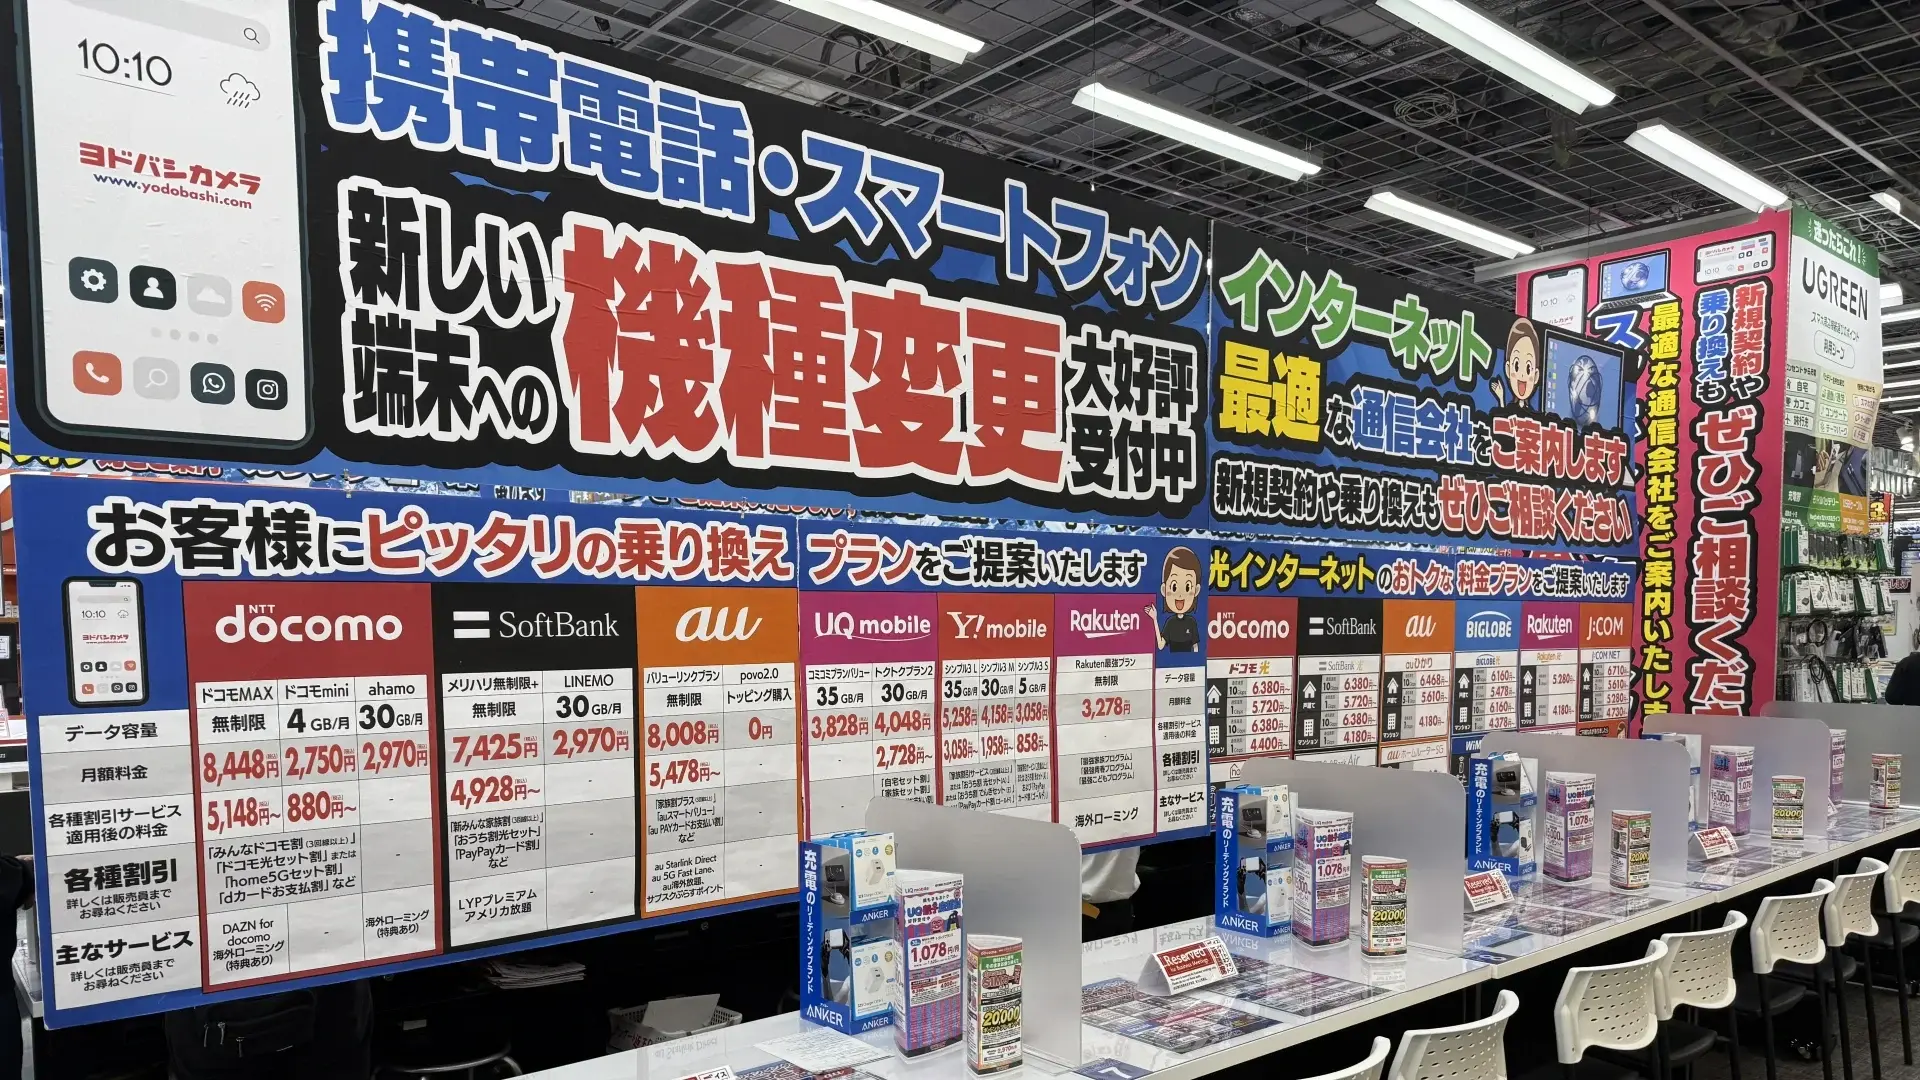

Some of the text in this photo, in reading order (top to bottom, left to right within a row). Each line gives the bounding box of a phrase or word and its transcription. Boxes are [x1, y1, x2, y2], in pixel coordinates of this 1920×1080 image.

[77, 38, 173, 88] 10:10
[322, 0, 1202, 311] 携帯電話・スマートフォン
[79, 141, 262, 196] ヨドバシカメラ
[93, 172, 252, 210] www.yodobashi.com
[346, 186, 552, 322] 新しい
[1802, 256, 1868, 321] UGREEN
[1219, 248, 1491, 381] インターネット
[1695, 289, 1730, 404] 乗り換えも
[1730, 280, 1768, 401] 新規契約や
[562, 223, 1063, 486] 機種変更
[350, 311, 552, 436] 端末への
[1068, 329, 1197, 423] 大好評
[1070, 416, 1195, 500] 受付中
[1215, 459, 1634, 544] 新規契約や乗り換えもぜひご相談ください
[93, 501, 790, 578] お客様にピッタリの乗り換え
[808, 537, 1146, 588] プランをご提案いたします
[81, 609, 106, 619] 10:10
[248, 604, 276, 614] NTT
[214, 604, 403, 644] docomo
[498, 610, 620, 638] SoftBank
[675, 606, 763, 642] au
[814, 611, 931, 640] UQ mobile
[946, 611, 1047, 639] Y! mobile
[1069, 609, 1140, 633] Rakuten
[1207, 612, 1290, 639] docomo
[1326, 615, 1377, 636] SoftBank
[1405, 614, 1437, 638] au
[1466, 620, 1512, 639] BIGLOBE
[1526, 614, 1573, 634] Rakuten
[646, 670, 720, 684] バリューリンクプラン
[740, 668, 779, 684] povo2.0
[875, 666, 933, 678] トクトクプラン2
[1229, 660, 1270, 675] ドコモ光
[285, 683, 349, 699] ドコモmini
[368, 682, 416, 696] ahamo
[447, 676, 539, 692] メリハリ無制限+
[564, 674, 614, 687] LINEMO
[1094, 675, 1118, 687] 無制限
[202, 685, 274, 703] ドコモMAX
[666, 693, 702, 707] 無制限
[727, 688, 792, 704] トッピング購入
[816, 686, 838, 706] 35
[881, 683, 904, 702] 30
[359, 704, 394, 730] 30
[472, 702, 516, 718] 無制限
[556, 695, 589, 718] 30
[212, 714, 266, 733] 無制限
[287, 708, 350, 733] 4 GB/月
[65, 723, 158, 742] データ容量
[1162, 750, 1200, 767] 各種割引
[81, 765, 148, 783] 月額料金
[1159, 791, 1205, 807] 主なサービス
[1474, 763, 1488, 854] 充電のリーディングブランド
[48, 804, 182, 829] 各種割引サービス
[1075, 807, 1139, 828] 海外ローミング
[66, 823, 168, 845] 適用後の料金
[678, 832, 695, 844] など
[1221, 797, 1234, 908] 充電のリーディングブランド
[1273, 842, 1291, 852] ANKER
[488, 856, 508, 869] など
[654, 855, 717, 872] au Starlink Direct
[1474, 859, 1511, 873] ANKER
[64, 858, 177, 893] 各種割引
[678, 868, 693, 879] Fast
[1466, 876, 1494, 889] Reserved
[66, 889, 172, 910] 詳しくは販売員まで
[458, 889, 537, 911] LYPプレミアム
[79, 901, 161, 920] お尋ねください
[365, 909, 430, 928] 海外ローミング
[465, 902, 532, 923] アメリカ放題
[862, 910, 889, 922] ANKER
[222, 918, 274, 935] DAZN for
[377, 923, 420, 938] (特典あり)
[803, 849, 818, 994] 充電のリーディングブランド
[1222, 915, 1259, 932] ANKER
[56, 930, 194, 966] 主なサービス
[213, 940, 285, 961] 海外ローミング
[227, 933, 271, 947] docomo
[225, 956, 273, 972] (特典あり)
[1162, 948, 1207, 968] Reserved
[71, 958, 175, 983] 詳しくは販売員まで
[83, 971, 164, 992] お尋ねください
[806, 1004, 843, 1028] ANKER
[862, 1017, 889, 1032] ANKER
